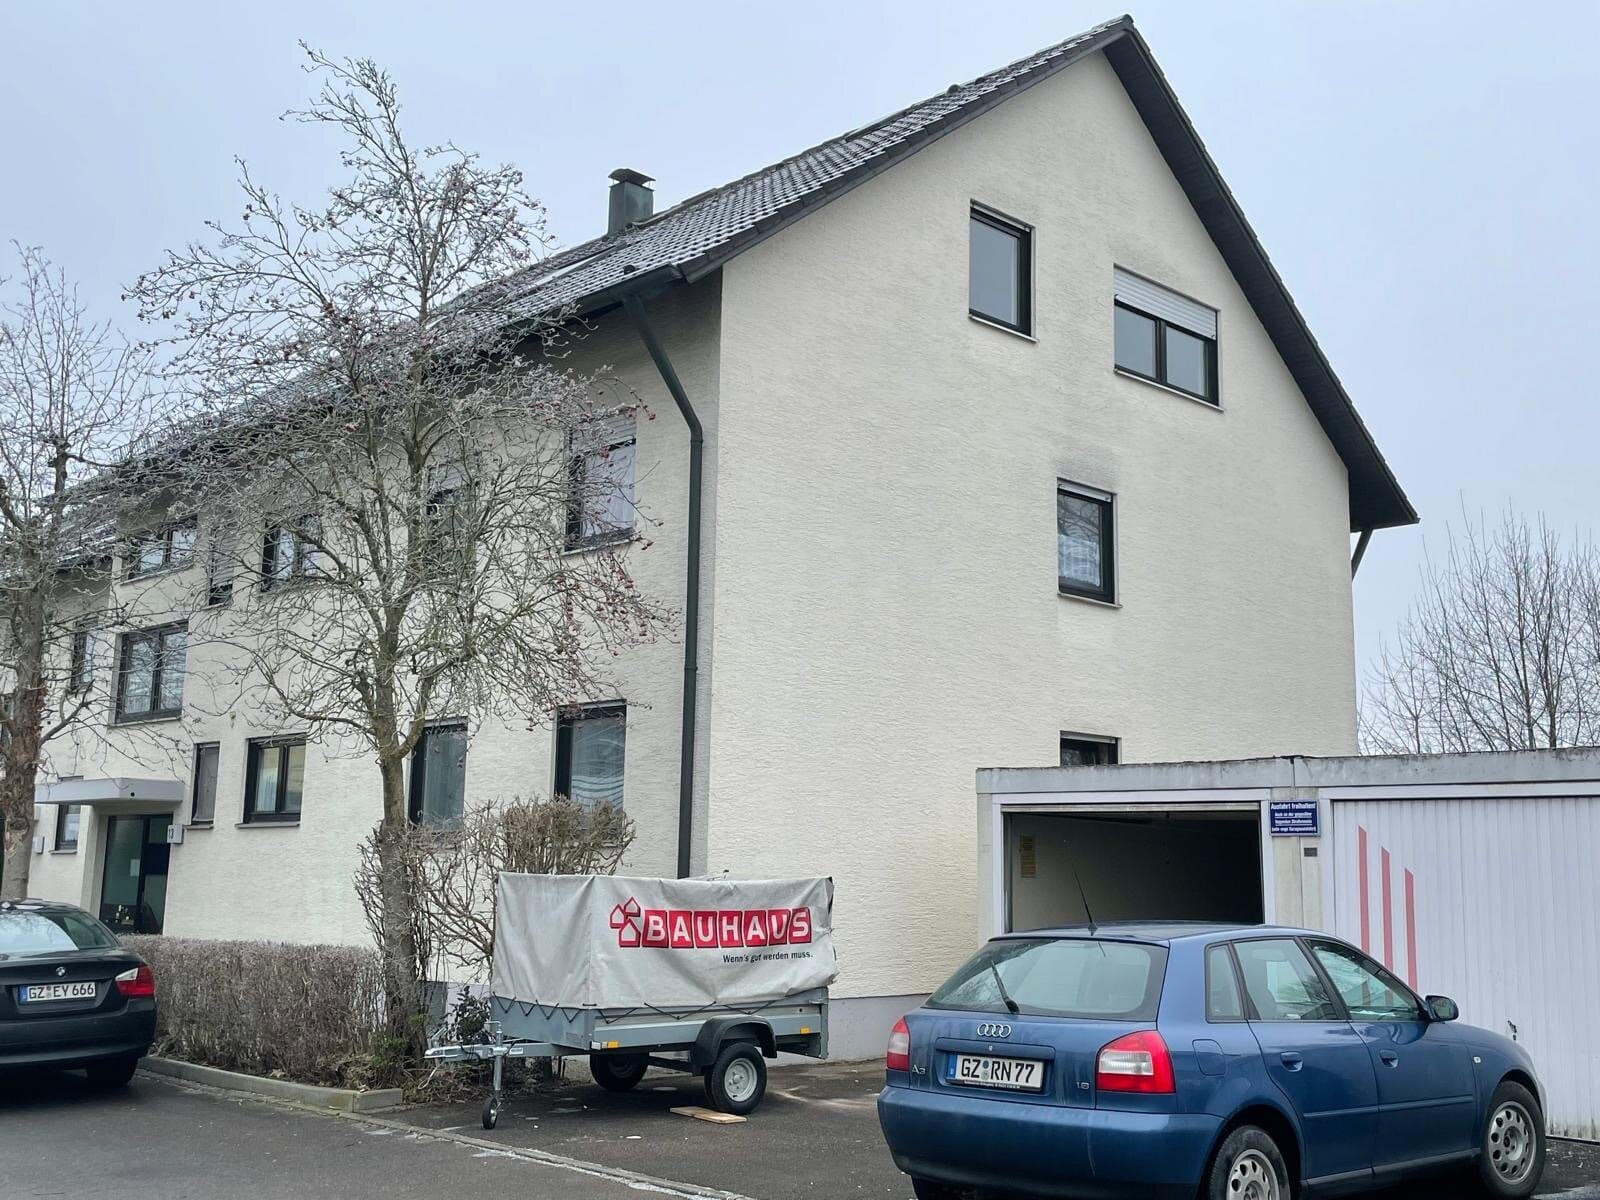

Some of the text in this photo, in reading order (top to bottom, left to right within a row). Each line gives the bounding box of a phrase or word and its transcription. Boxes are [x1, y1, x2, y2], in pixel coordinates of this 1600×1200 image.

[645, 911, 810, 943] BAUHAUS
[723, 951, 814, 964] Wenn's gut werden muss.
[29, 984, 94, 999] GZ EY 666
[961, 1058, 1035, 1083] GZ RN 77
